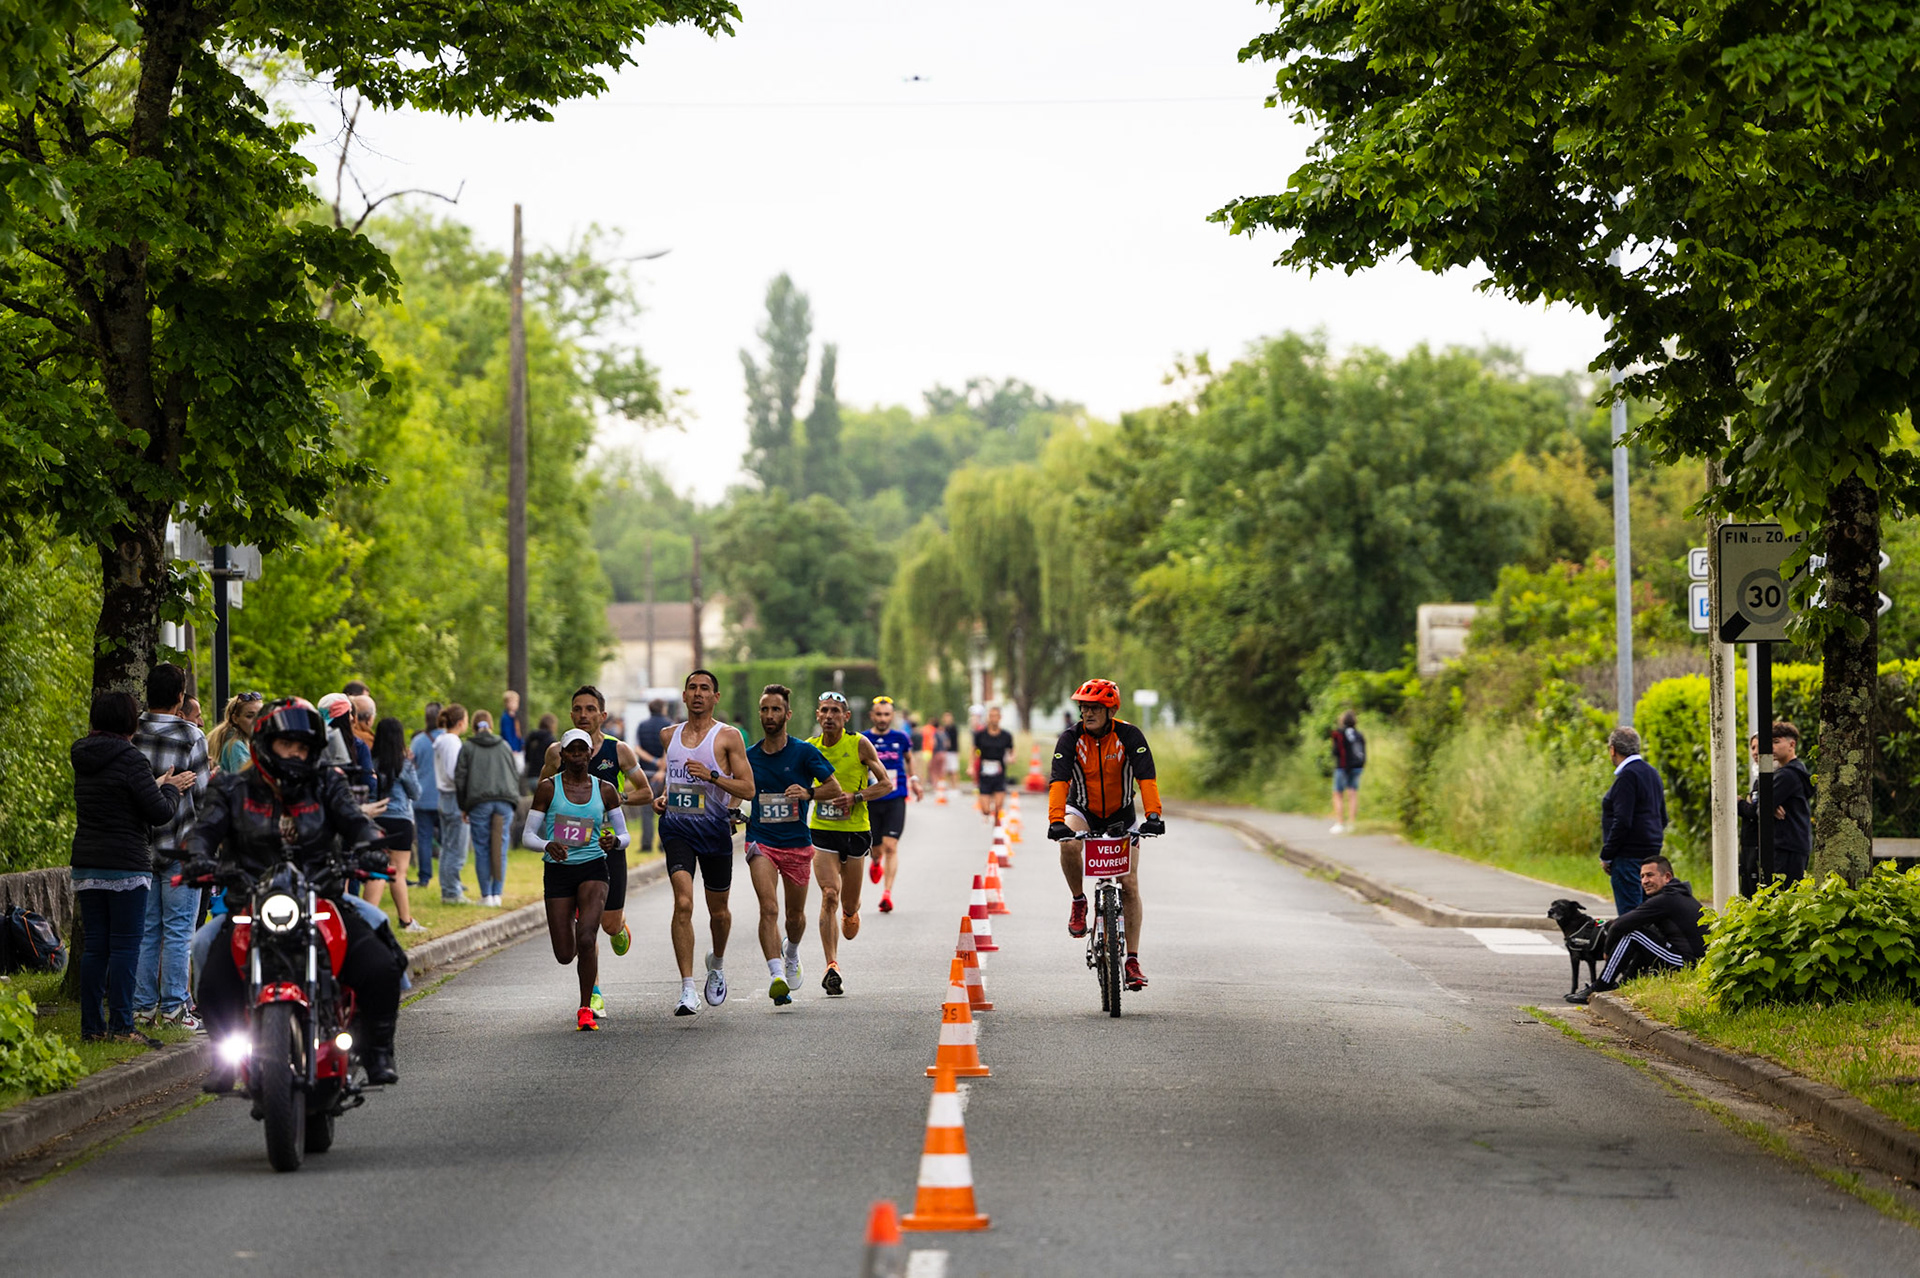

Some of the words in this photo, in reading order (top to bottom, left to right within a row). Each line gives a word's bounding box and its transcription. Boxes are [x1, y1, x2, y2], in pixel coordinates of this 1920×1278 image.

[1725, 532, 1748, 544] FIN
[1751, 536, 1762, 544] DE
[1748, 585, 1781, 608] 30
[675, 794, 692, 808] 15
[763, 804, 790, 818] 515
[563, 826, 580, 841] 12
[1097, 844, 1121, 855] VELO
[1088, 856, 1128, 868] OUVREUR
